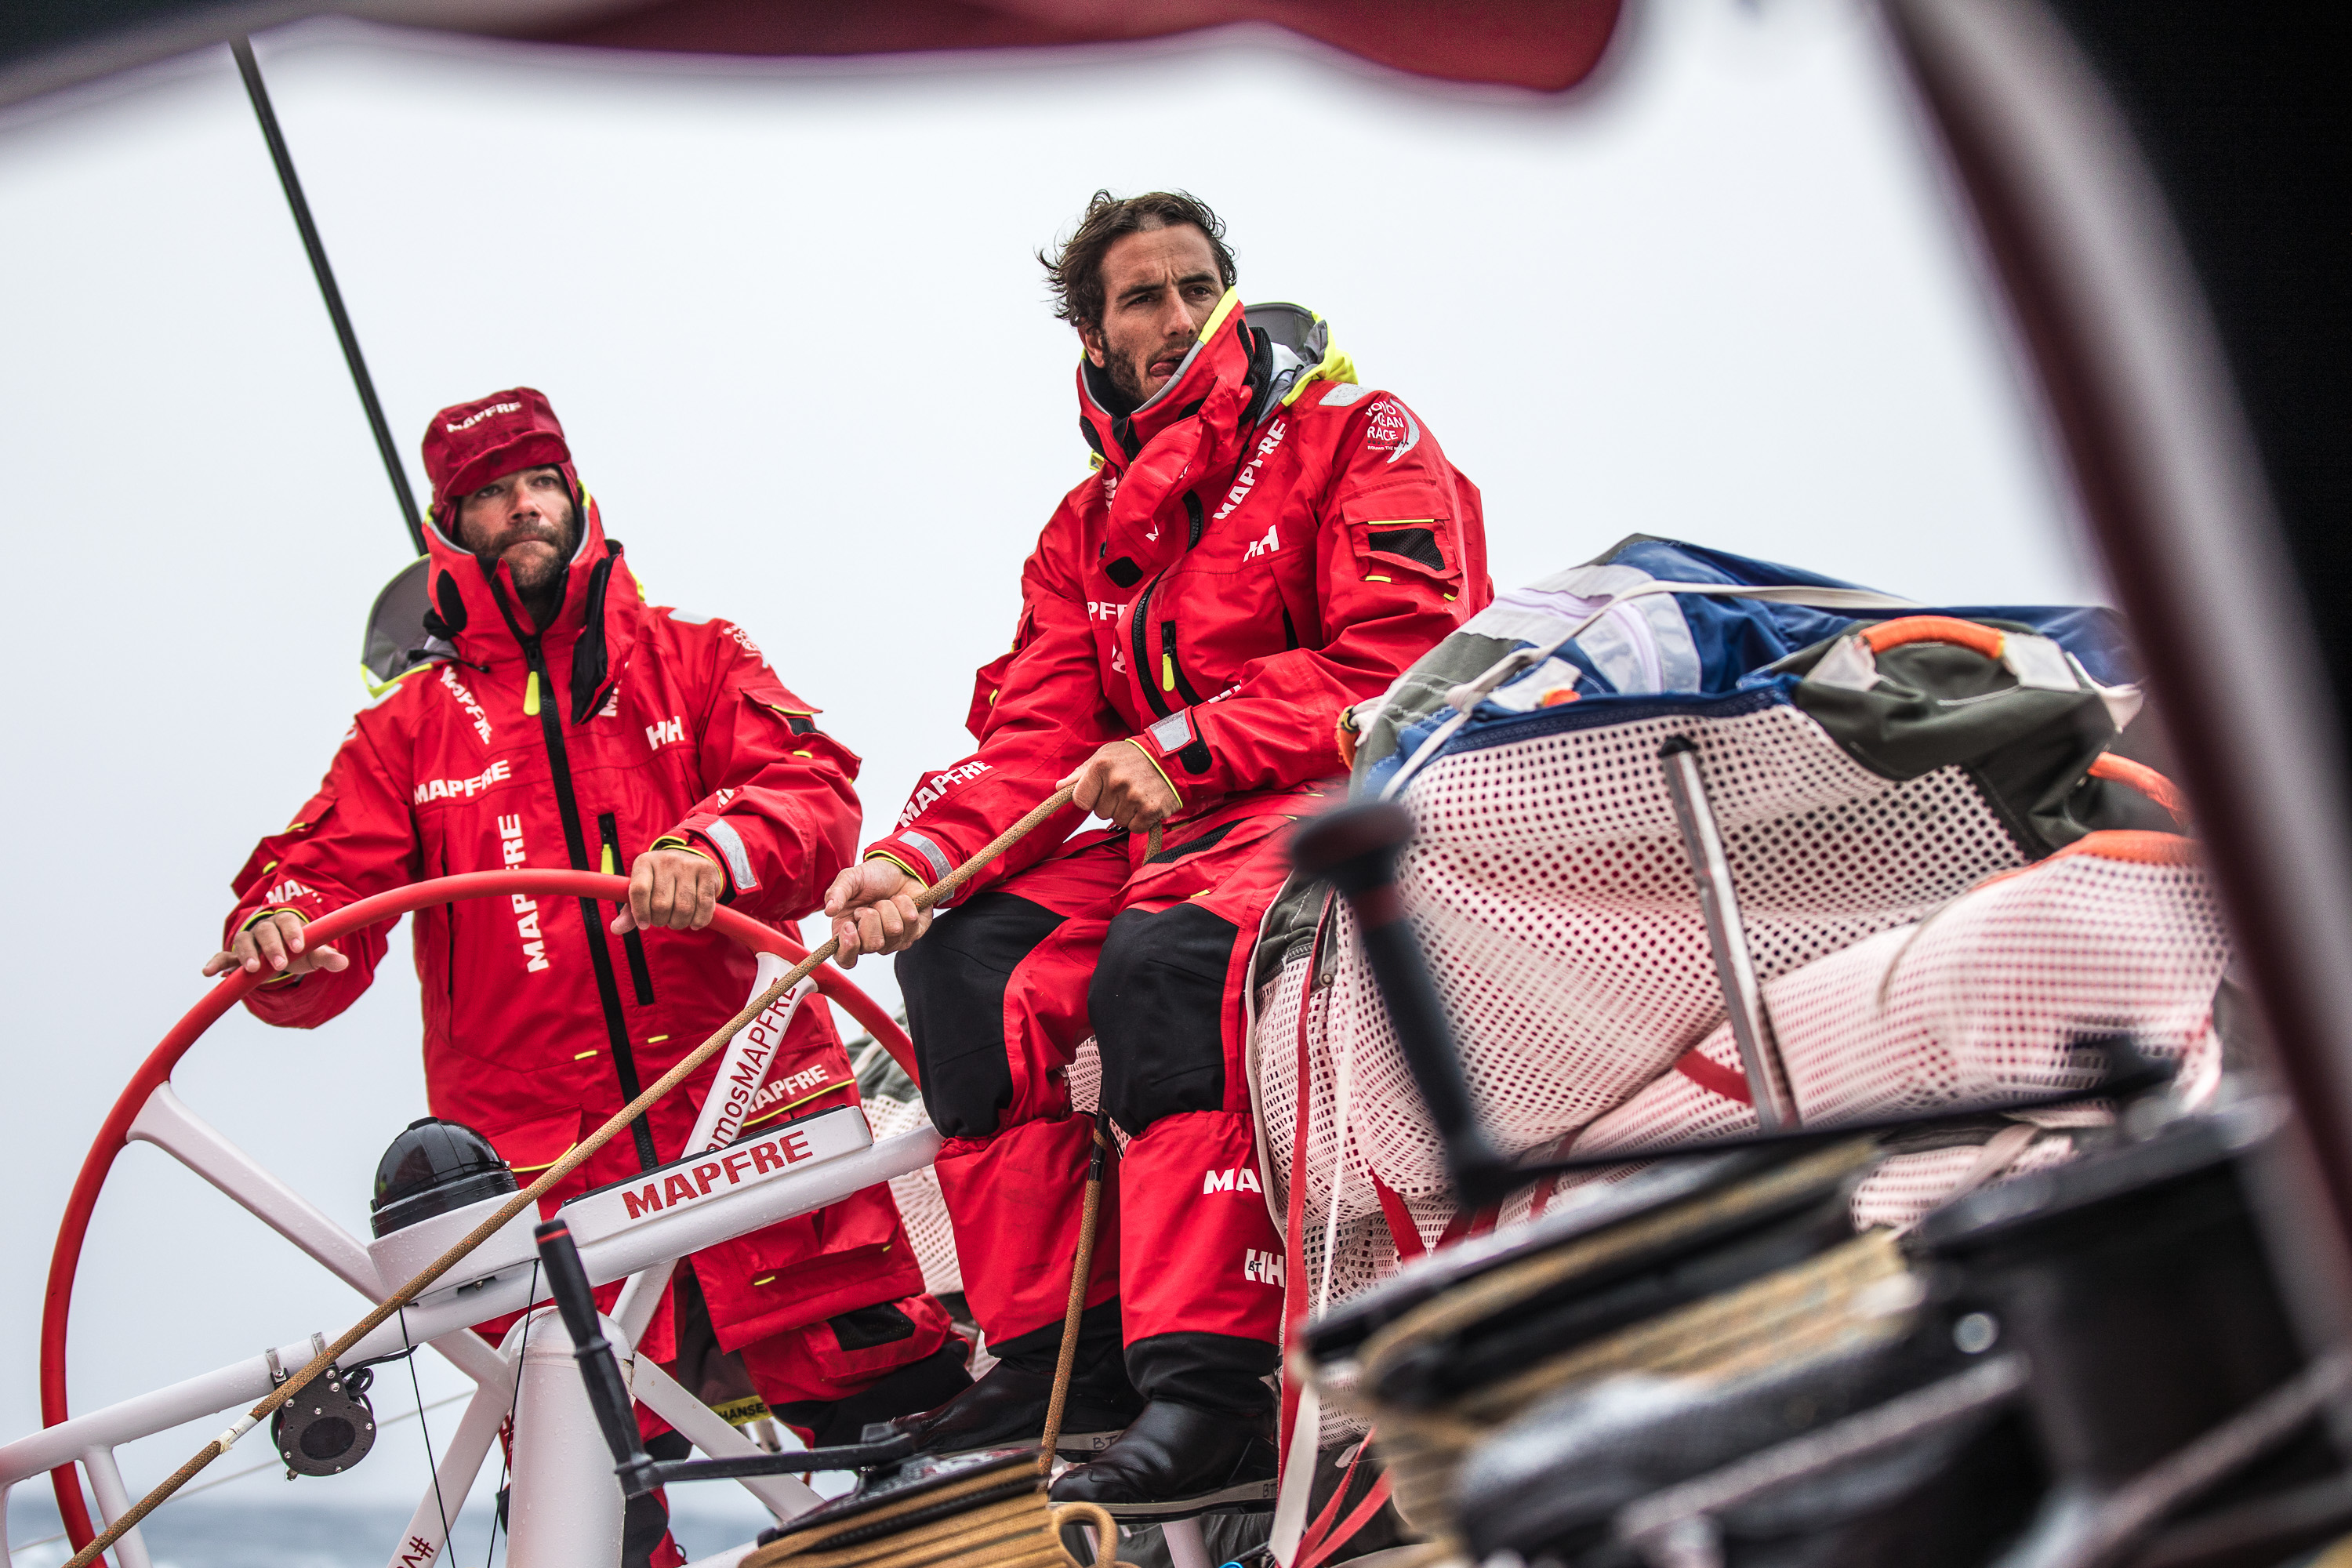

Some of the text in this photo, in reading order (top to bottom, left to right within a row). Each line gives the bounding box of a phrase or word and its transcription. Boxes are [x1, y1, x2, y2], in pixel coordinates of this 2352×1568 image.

[1367, 426, 1398, 441] RACE
[645, 715, 684, 751] HH
[413, 759, 511, 805] MAPFRE
[898, 760, 993, 828] MAPFRE
[497, 813, 550, 973] MAPRE
[621, 1130, 813, 1220] MAPFRE
[1244, 1248, 1285, 1288] HH
[717, 1403, 768, 1421] HANSE
[1092, 1435, 1119, 1450] BT
